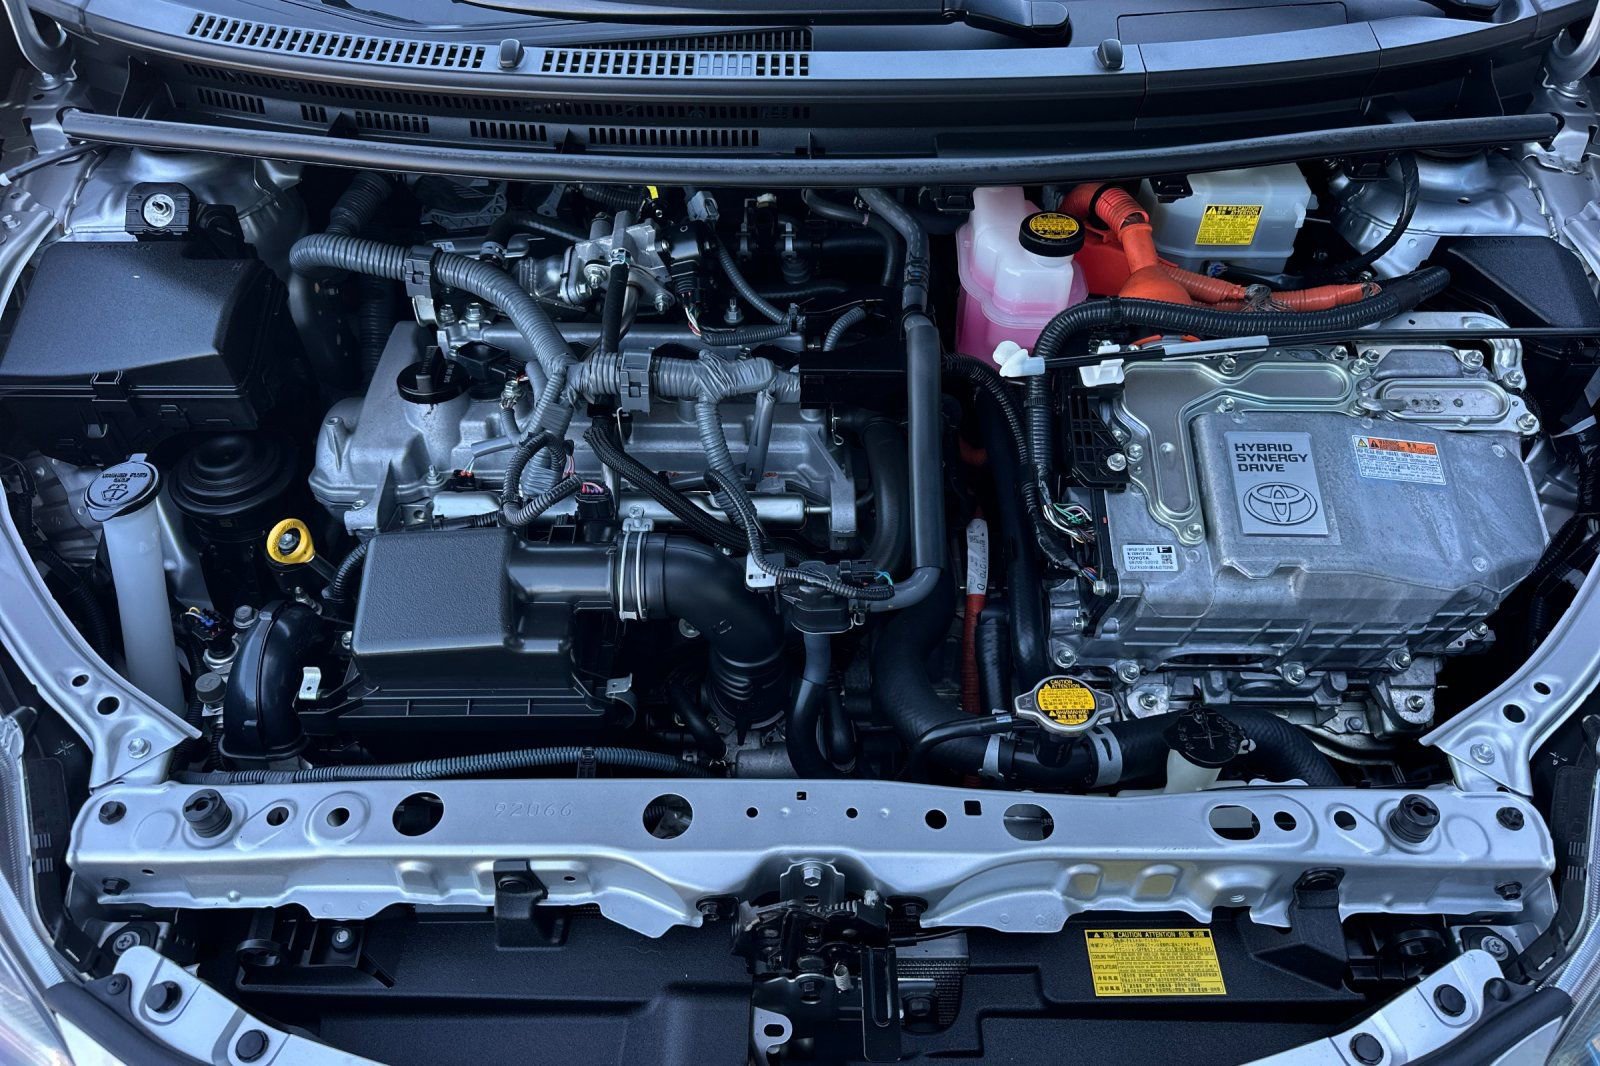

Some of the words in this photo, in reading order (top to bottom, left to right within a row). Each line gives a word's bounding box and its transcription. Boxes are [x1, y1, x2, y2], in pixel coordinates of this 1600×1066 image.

[1234, 443, 1292, 452] HYBRID
[1236, 453, 1308, 462] SYNERGY
[1238, 464, 1285, 472] DRIVE
[495, 802, 571, 817] 92066
